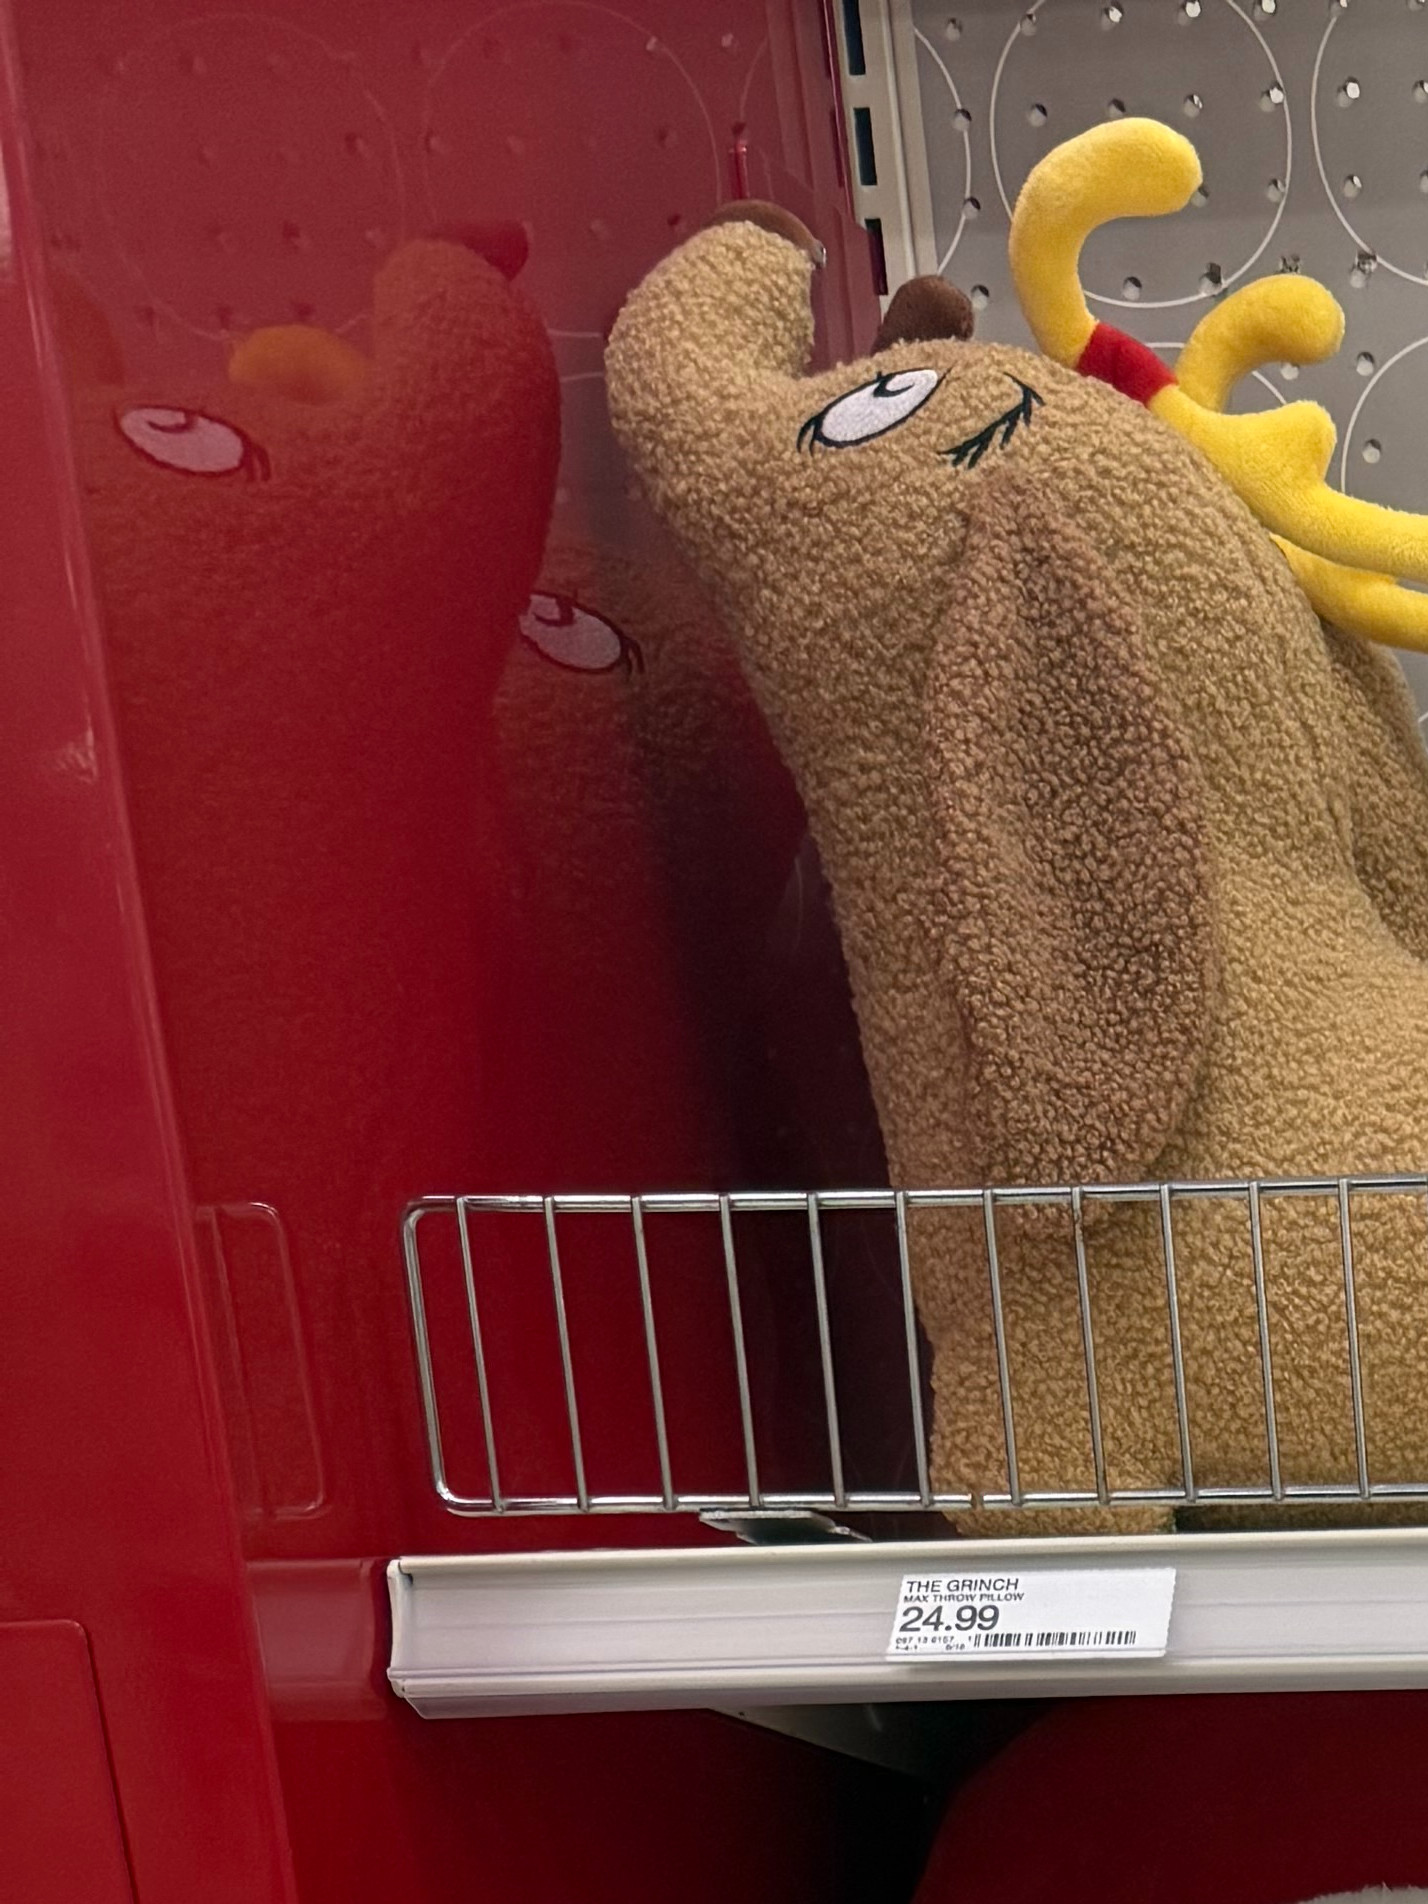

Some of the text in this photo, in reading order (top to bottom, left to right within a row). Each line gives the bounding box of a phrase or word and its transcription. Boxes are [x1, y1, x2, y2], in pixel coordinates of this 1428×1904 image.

[907, 1578, 1020, 1593] THE GRINCH
[904, 1592, 1025, 1603] MAX THROW PILLOW
[900, 1604, 1000, 1632] 24.99
